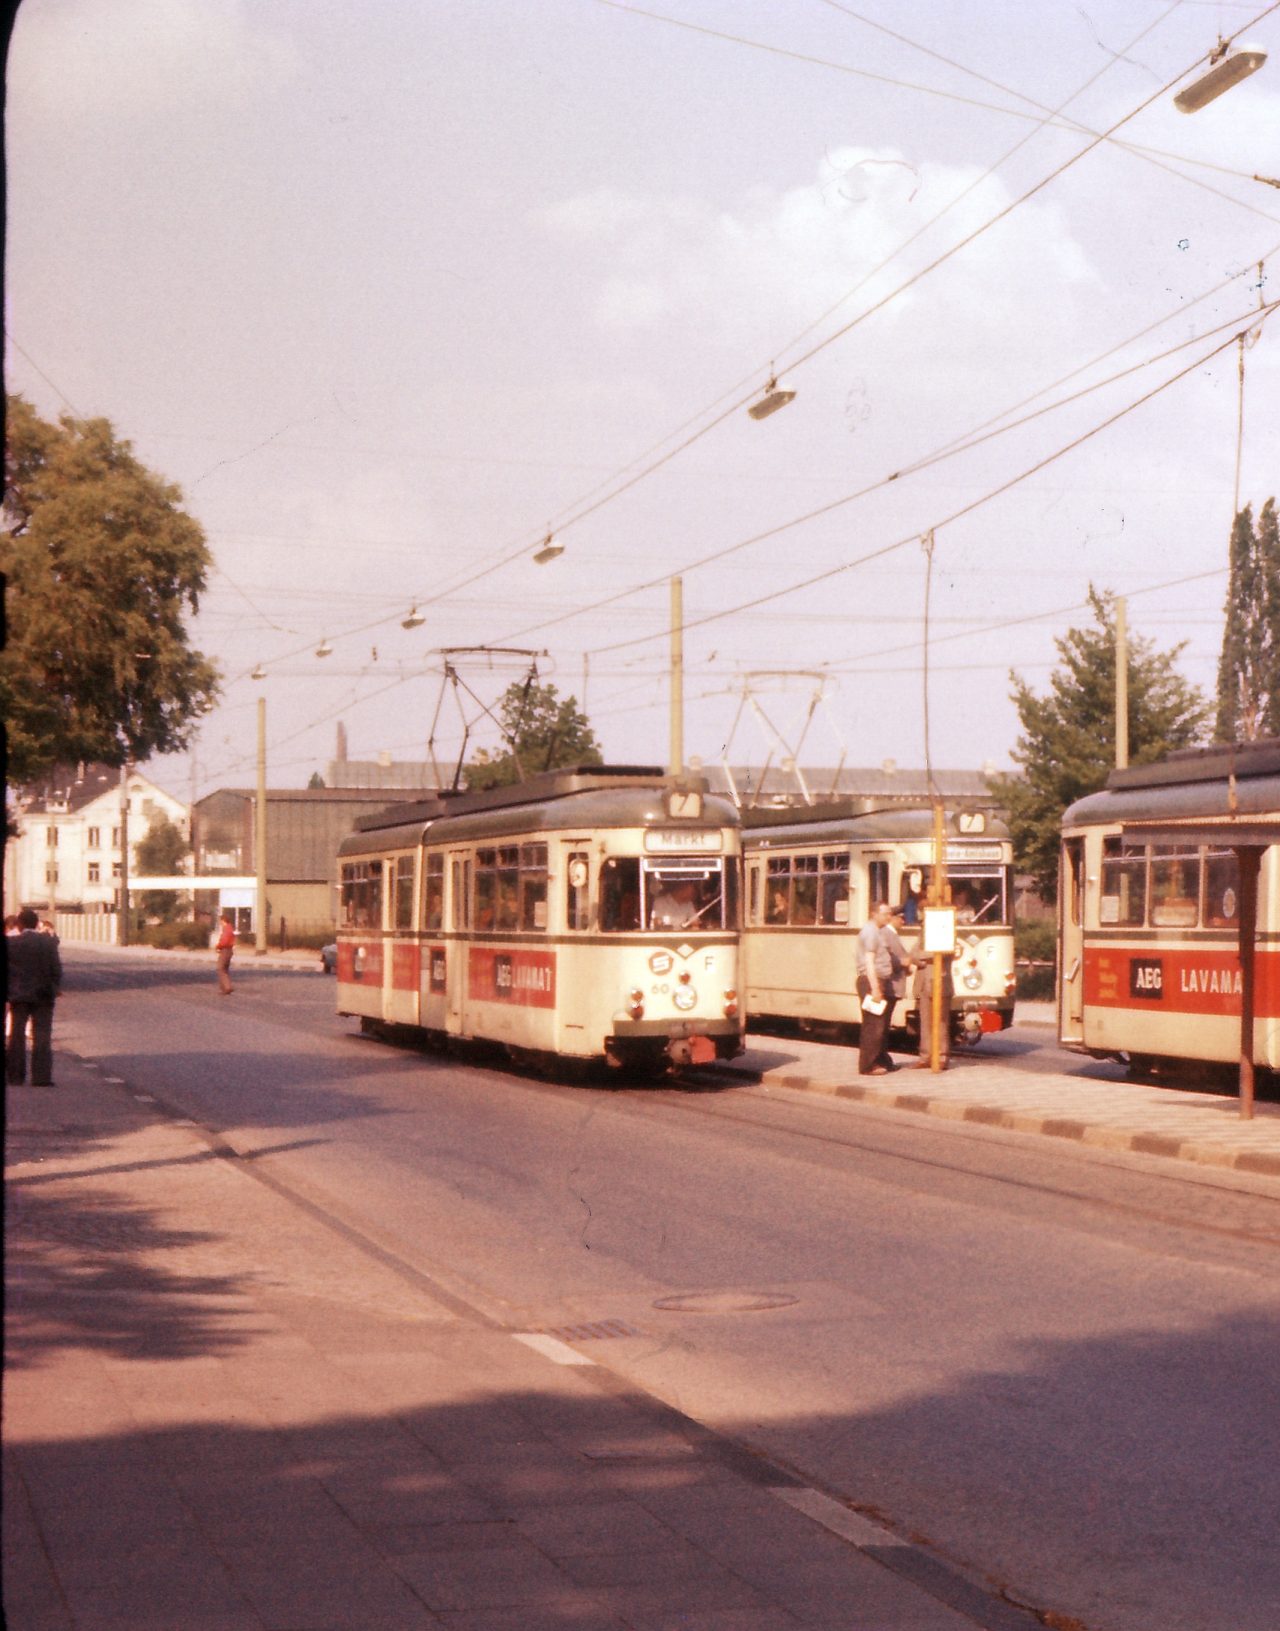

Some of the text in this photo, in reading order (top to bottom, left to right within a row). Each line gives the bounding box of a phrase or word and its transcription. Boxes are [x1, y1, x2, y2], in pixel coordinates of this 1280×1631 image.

[677, 792, 692, 812] 7
[966, 812, 976, 829] 7
[661, 829, 705, 845] Markt
[704, 956, 714, 970] F
[1136, 967, 1162, 988] AEG
[1181, 969, 1244, 993] LAVAMA
